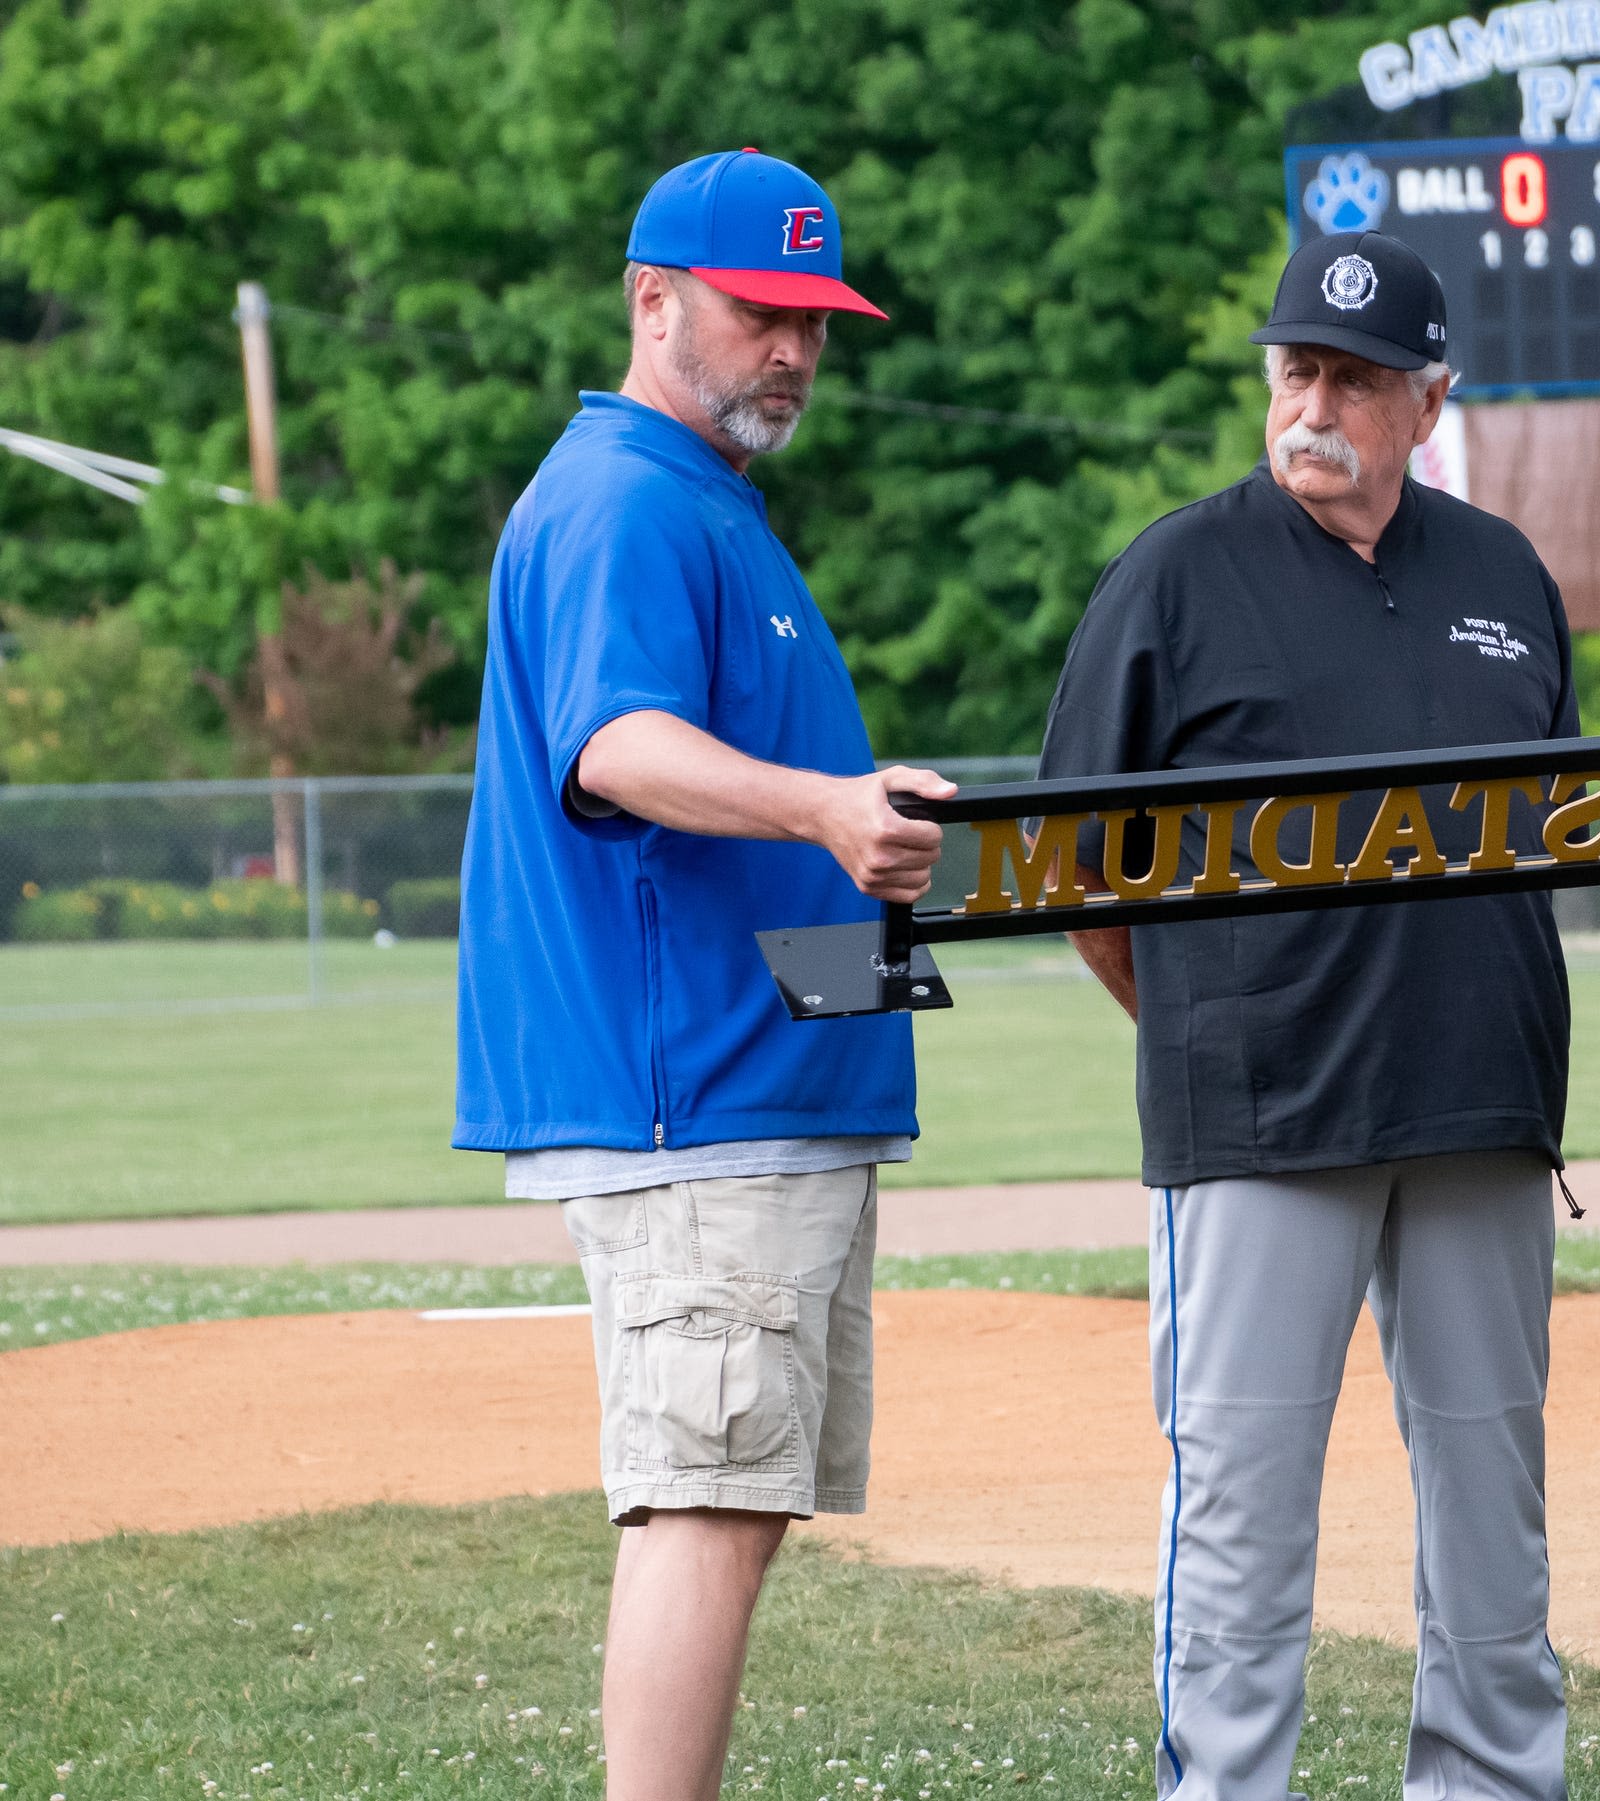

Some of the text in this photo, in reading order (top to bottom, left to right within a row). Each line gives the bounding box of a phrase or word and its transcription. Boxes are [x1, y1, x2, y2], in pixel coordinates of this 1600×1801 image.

[1397, 165, 1494, 216] BALL
[1501, 152, 1547, 227] 0
[782, 207, 824, 255] C
[1479, 229, 1502, 270] 1
[1523, 227, 1548, 269] 2
[1334, 258, 1372, 280] AMERICAN
[1330, 291, 1362, 306] LEGION
[1463, 617, 1490, 630] POST
[1449, 625, 1530, 656] American Legion
[1478, 645, 1504, 658] POST
